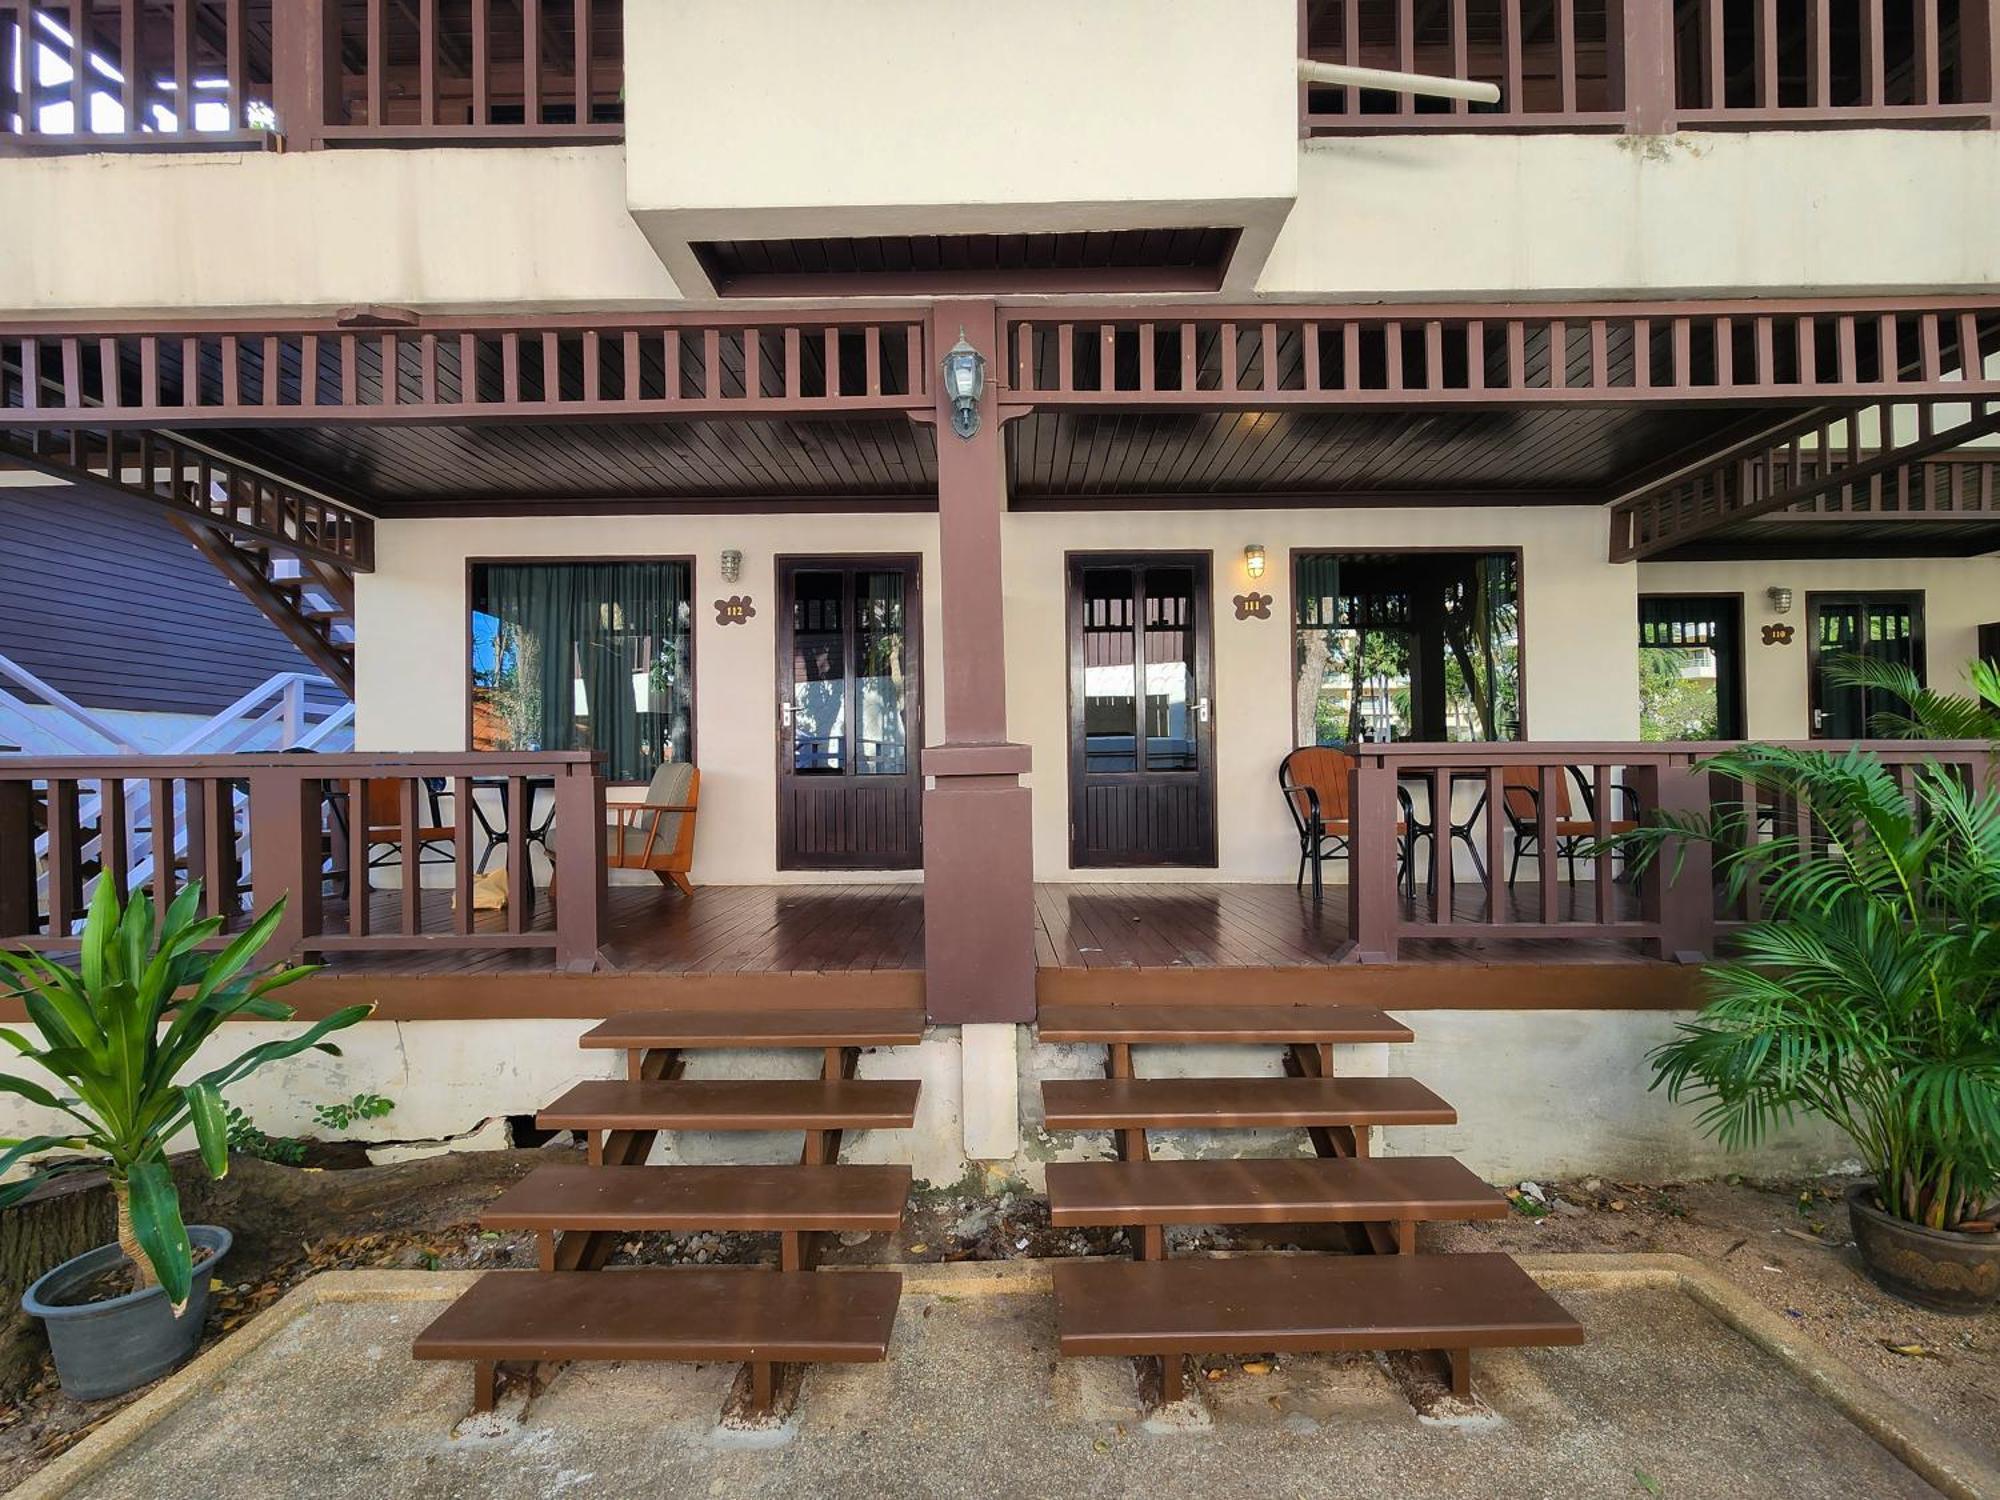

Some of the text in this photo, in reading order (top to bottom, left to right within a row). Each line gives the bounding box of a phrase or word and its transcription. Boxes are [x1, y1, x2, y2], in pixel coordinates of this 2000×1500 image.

[1244, 600, 1260, 610] 111
[727, 606, 743, 616] 112
[1772, 630, 1786, 639] 110
